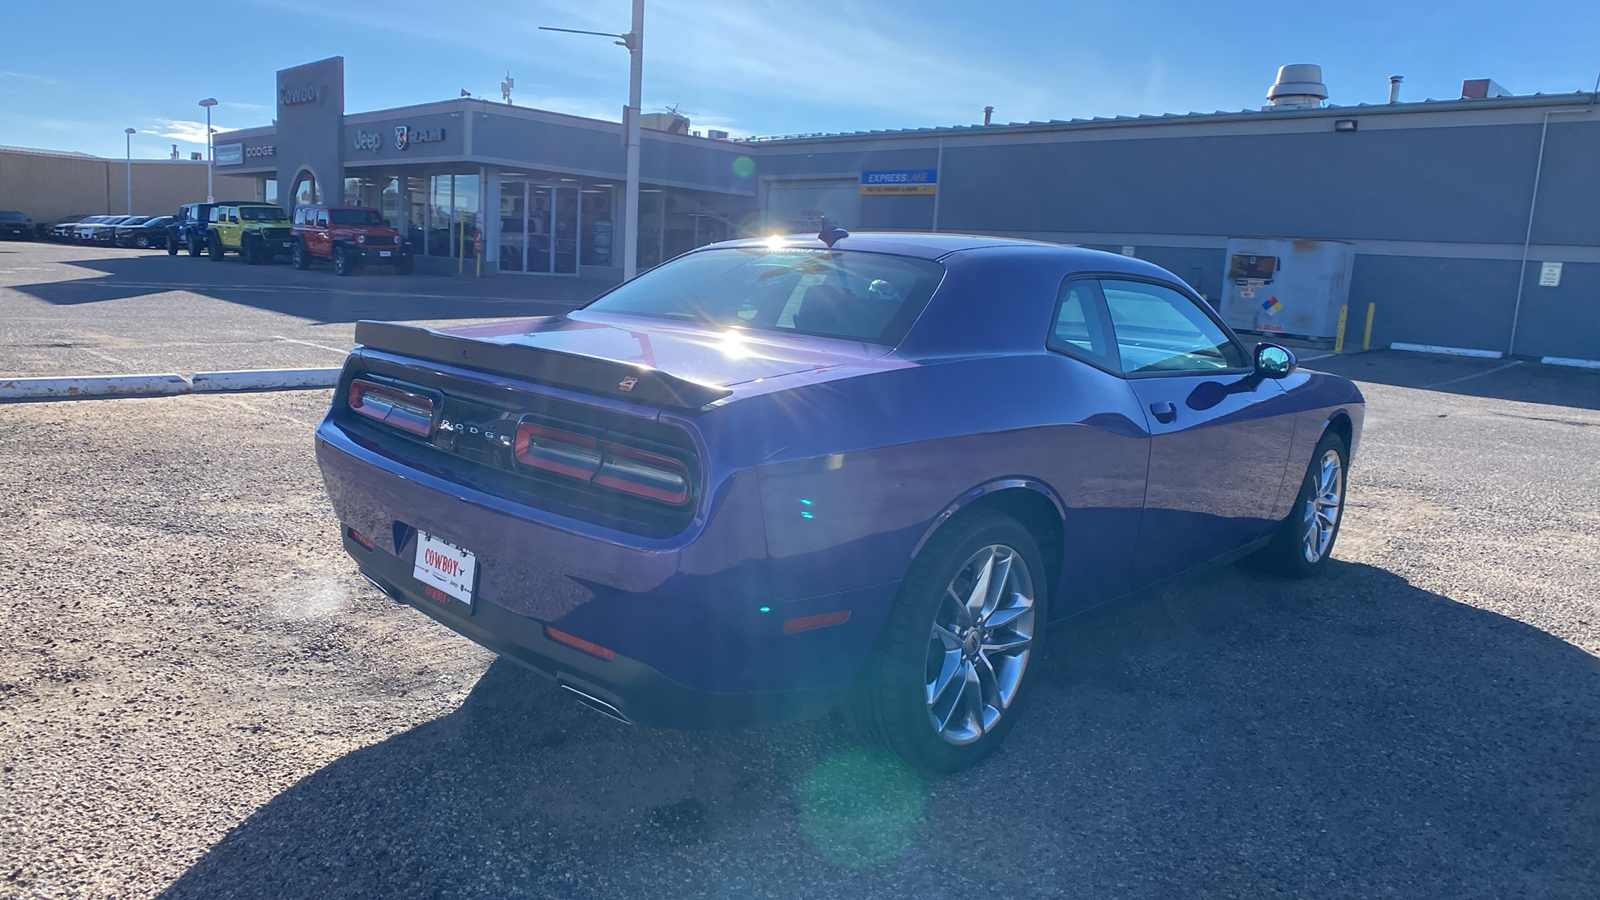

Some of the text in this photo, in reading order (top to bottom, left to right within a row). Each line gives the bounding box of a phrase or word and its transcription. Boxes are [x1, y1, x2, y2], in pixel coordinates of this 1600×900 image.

[354, 128, 381, 152] Jeep
[408, 128, 444, 143] RAM
[246, 145, 274, 157] DODGE
[440, 420, 510, 445] DODGE
[425, 548, 459, 577] COWBOY
